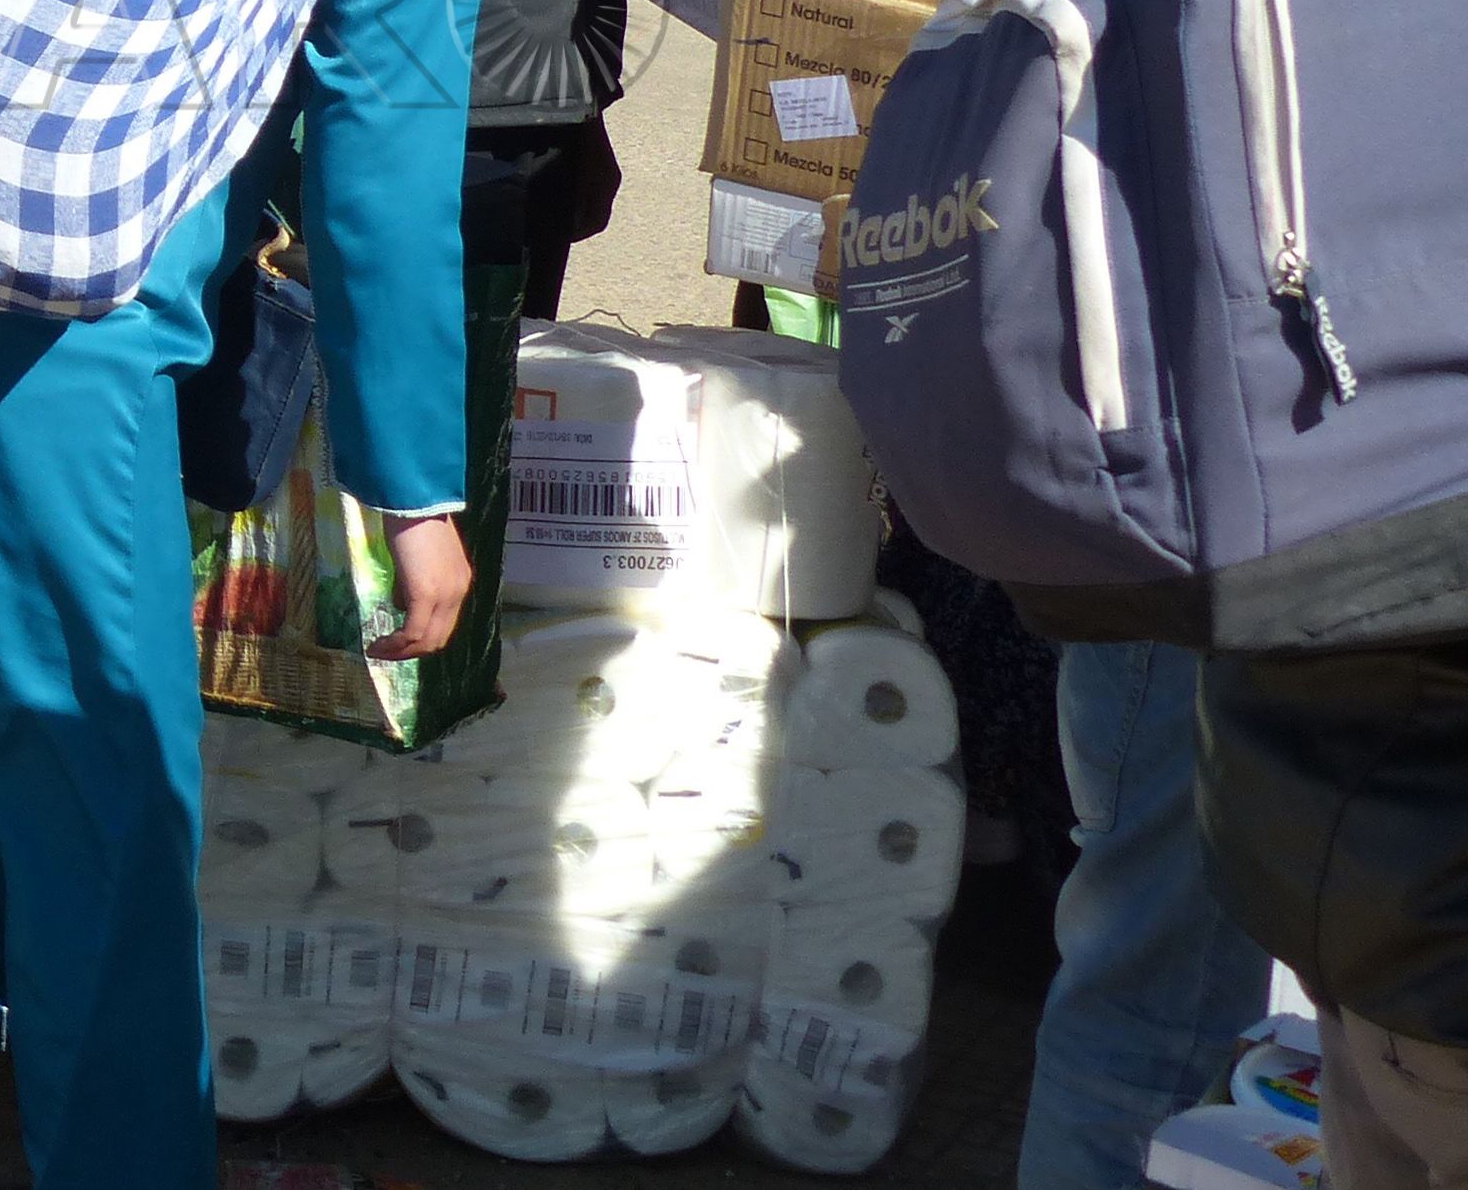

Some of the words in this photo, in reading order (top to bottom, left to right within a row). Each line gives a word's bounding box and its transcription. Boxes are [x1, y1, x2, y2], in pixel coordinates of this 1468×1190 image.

[790, 1, 854, 30] Natural
[784, 51, 846, 75] Mezcla
[774, 149, 833, 178] Mezcla
[839, 172, 999, 269] Reebok
[1314, 295, 1358, 402] Reebok
